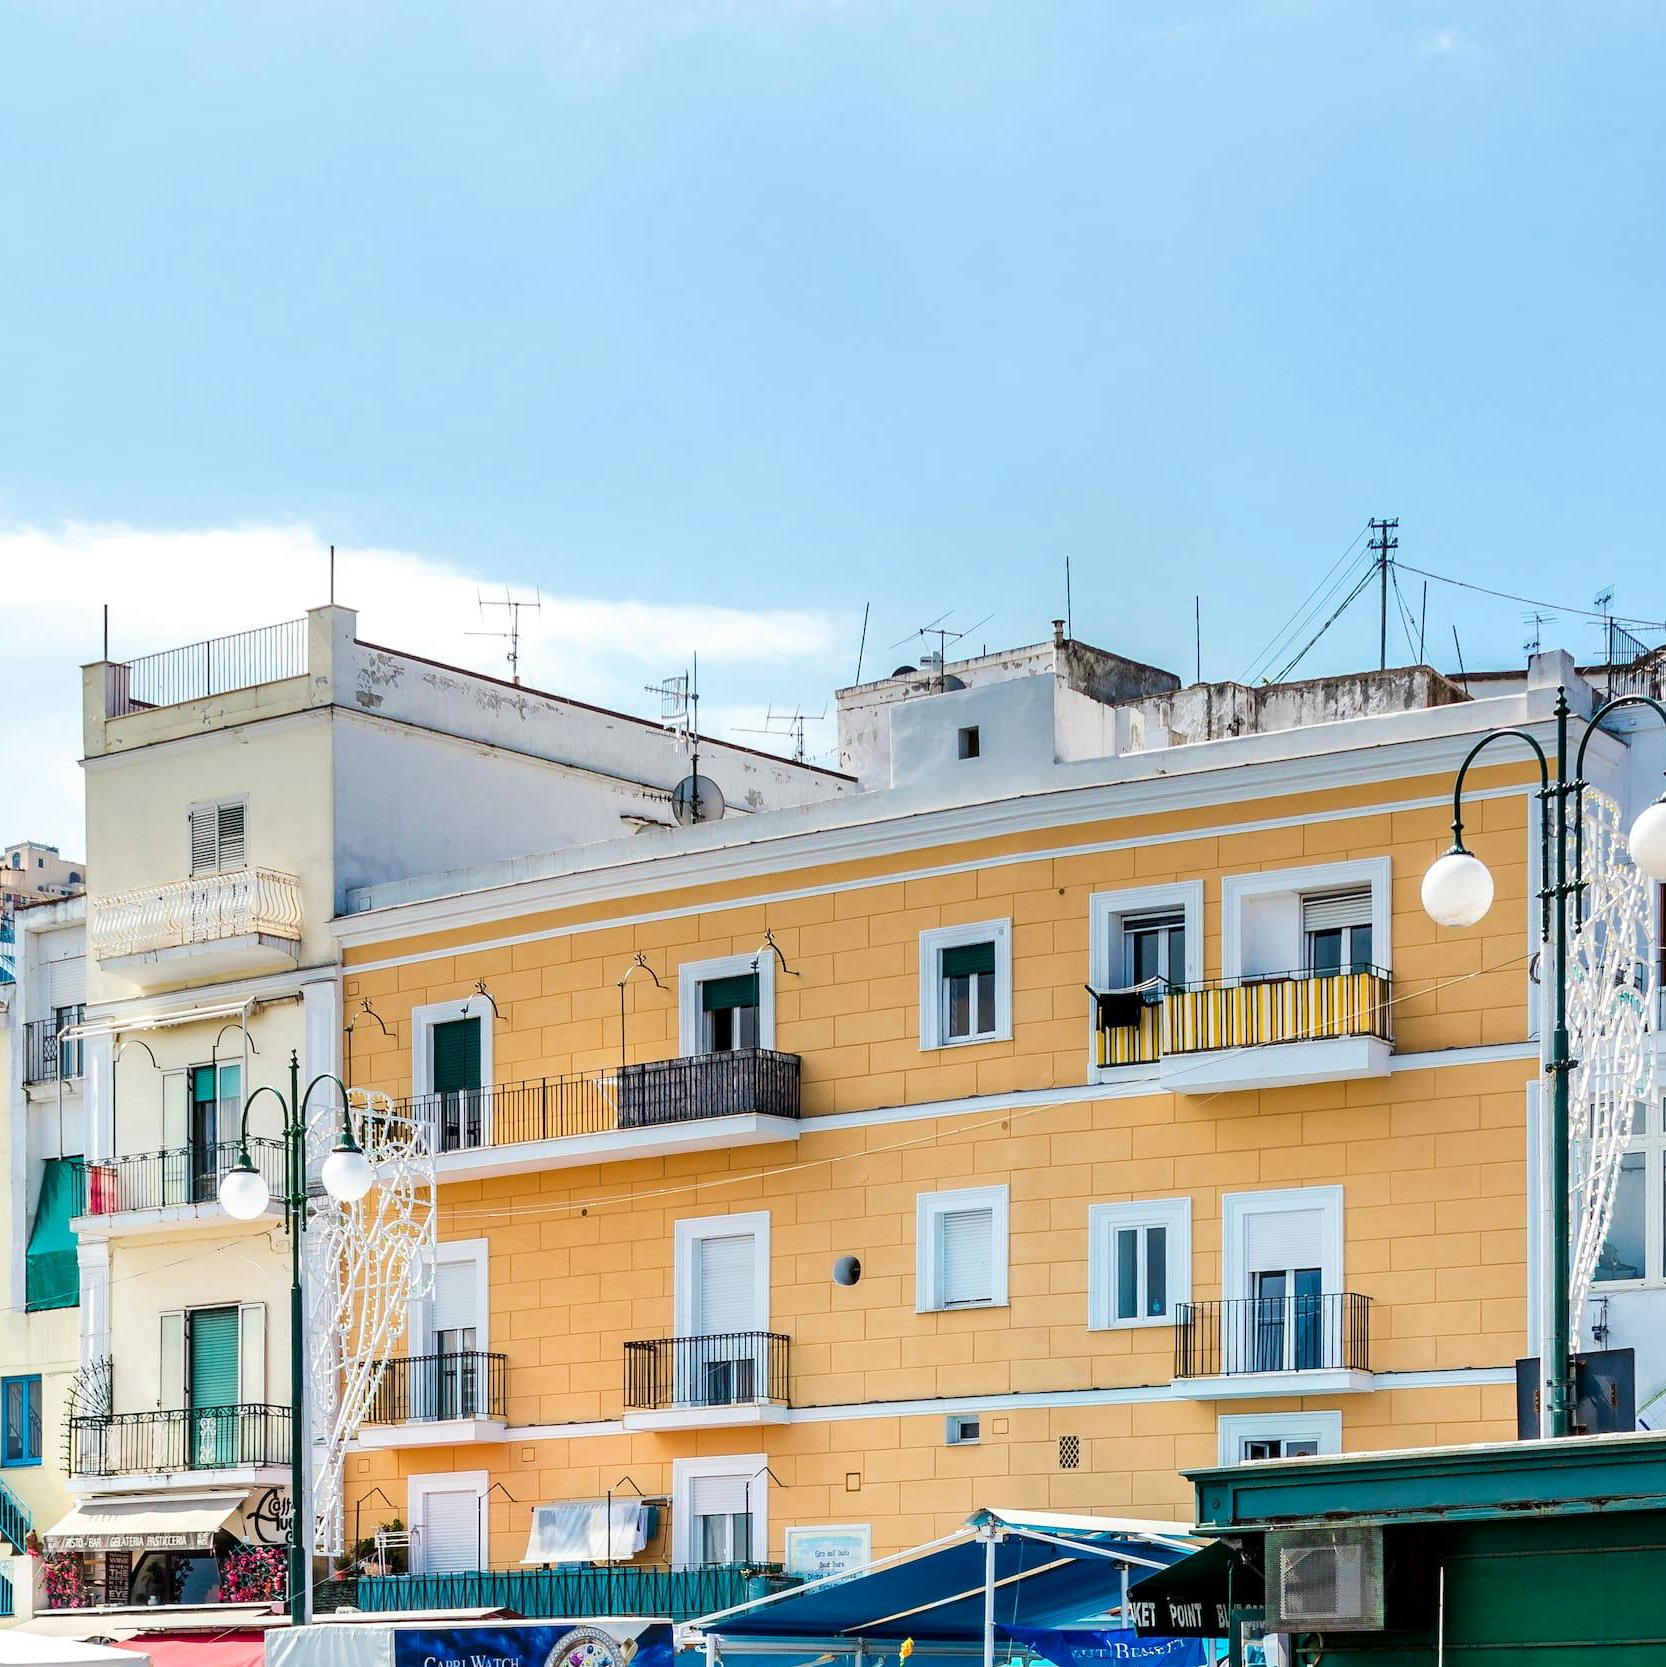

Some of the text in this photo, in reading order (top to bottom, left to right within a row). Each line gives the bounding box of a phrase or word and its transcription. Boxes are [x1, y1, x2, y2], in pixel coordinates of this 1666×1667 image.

[110, 1534, 144, 1547] GELATERIA
[147, 1532, 187, 1546] PASTICCERIA
[109, 1590, 129, 1598] EYE
[1170, 1603, 1203, 1628] POINT
